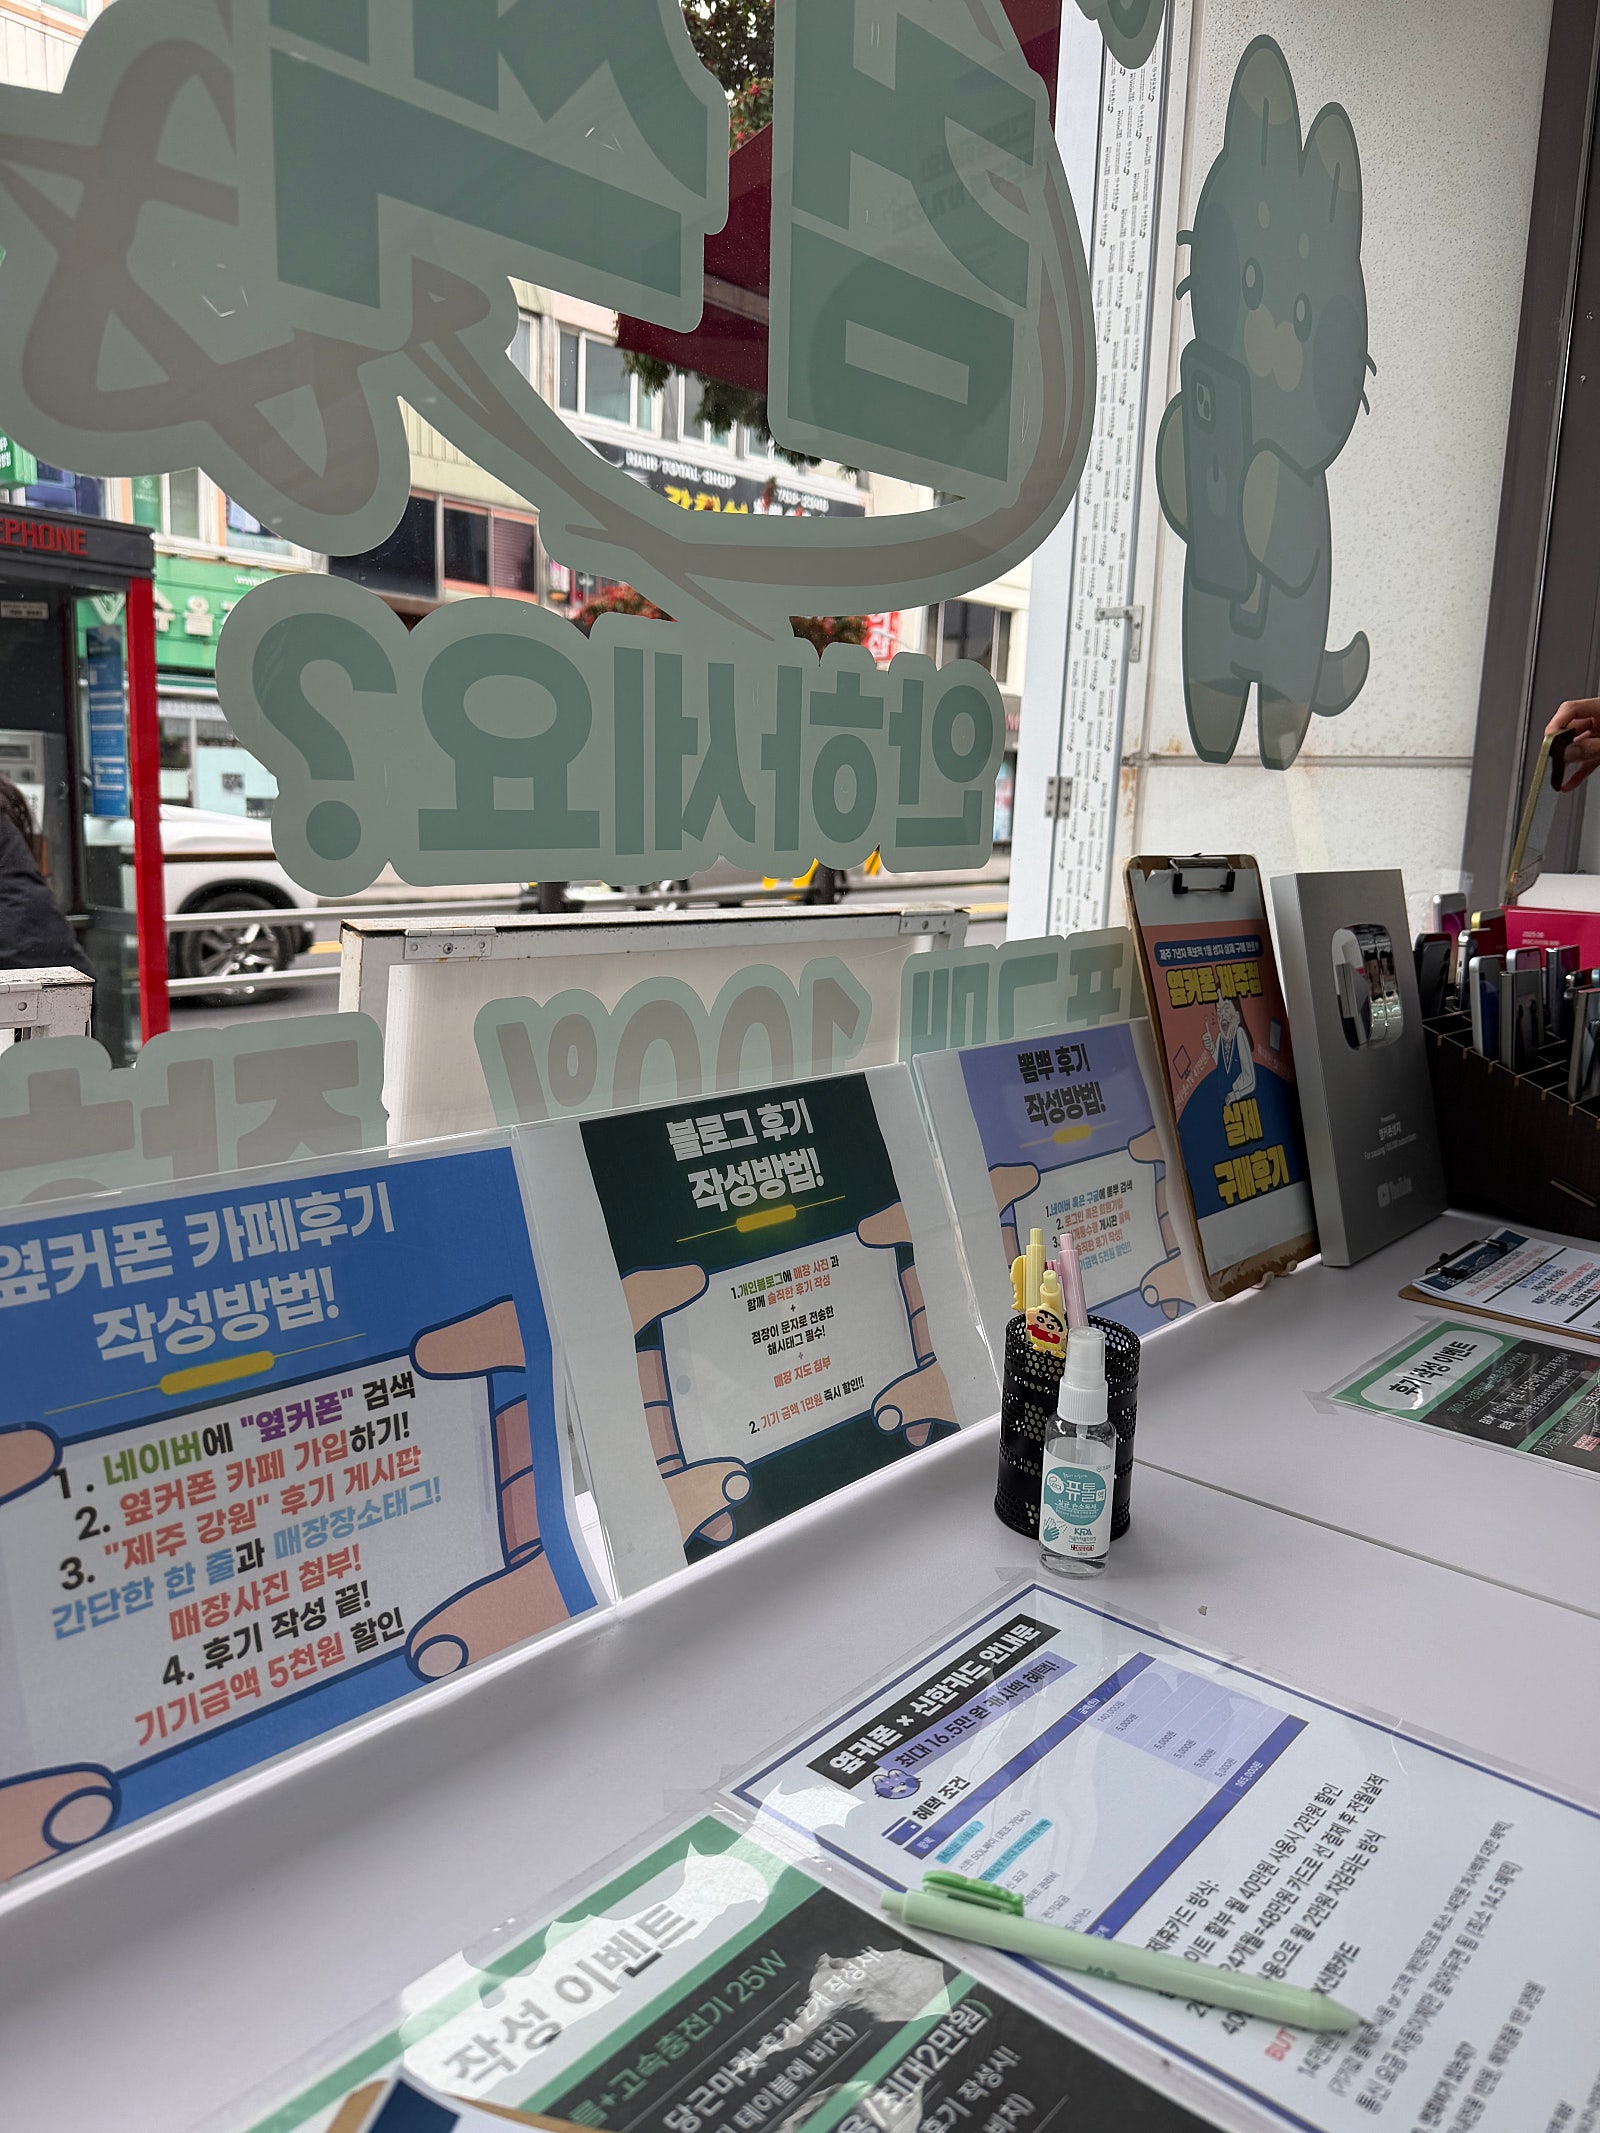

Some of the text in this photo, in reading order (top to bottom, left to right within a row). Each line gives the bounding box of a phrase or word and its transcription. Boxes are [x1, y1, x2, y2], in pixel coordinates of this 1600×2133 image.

[660, 460, 700, 481] TOTAL
[700, 469, 736, 489] SHOP
[0, 518, 88, 556] PHONE
[1167, 960, 1263, 1008] 옆커폰 제주점
[1017, 1043, 1091, 1085] 뽐뿌 후기
[1024, 1081, 1106, 1127] 작성방법!
[1223, 1098, 1263, 1148] 실제
[665, 1097, 815, 1163] 블로그 후기
[687, 1146, 825, 1214] 작성방법!
[1213, 1143, 1289, 1206] 구매후기
[1064, 1210, 1084, 1227] 로그인
[0, 1181, 396, 1306] 옆커폰 카페후기
[793, 1262, 812, 1282] 매장
[812, 1258, 830, 1276] 사진
[746, 1274, 832, 1312] 함께 솔직한 후기 작성
[93, 1266, 338, 1365] 작성방법!
[751, 1305, 835, 1345] 점장이 문자로 전송한
[767, 1326, 827, 1357] 해시태그 필수!
[1432, 1341, 1478, 1363] 이벤트
[774, 1356, 832, 1389] 매장 지도 첨부
[760, 1411, 780, 1430] 기기
[780, 1403, 800, 1421] 금액
[800, 1393, 823, 1416] 1만원
[823, 1385, 842, 1403] 즉시
[842, 1375, 866, 1396] 할인!!
[104, 1423, 233, 1486] 네이버에
[241, 1388, 354, 1442] "옆커폰"
[362, 1370, 417, 1411] 검색
[119, 1468, 215, 1527] 옆커폰
[226, 1450, 285, 1495] 카페
[294, 1412, 411, 1475] 가입하기!
[104, 1521, 187, 1571] "제주
[197, 1494, 270, 1542] 강원"
[281, 1479, 335, 1515] 후기
[344, 1445, 422, 1496] 게시판
[1074, 1527, 1093, 1536] KFDA
[51, 1476, 442, 1641] 간단한 한 줄과 매장장소태그!
[169, 1544, 363, 1642] 매장사진 첨부!
[161, 1580, 371, 1688] 4. 후기 작성 끝!
[134, 1606, 406, 1747] 기기금액 5천원 할인
[829, 1623, 1042, 1775] 옆커폰 신한카드 안내문
[894, 1743, 933, 1769] 최대
[1022, 1660, 1061, 1686] 혜택!
[1115, 1713, 1139, 1733] 5,000원
[1154, 1729, 1178, 1751] 5,000원
[1173, 1738, 1197, 1760] 5,000원
[1194, 1748, 1217, 1769] 5,000원
[1214, 1757, 1238, 1779] 5,000원
[1234, 1760, 1264, 1788] 165,000원
[1346, 1772, 1389, 1815] 전월실적
[912, 1775, 971, 1821] 혜택 조건
[1338, 1811, 1358, 1826] 후
[1312, 1843, 1335, 1860] 선
[1321, 1822, 1352, 1847] 결제
[1355, 1829, 1387, 1853] 방식
[1203, 1782, 1344, 1938] 할부 월 40만원 사용시 2만원 할인
[1286, 1856, 1324, 1892] 카드로
[1324, 1853, 1370, 1897] 차감되는
[1145, 1880, 1221, 1952] 제휴카드 방식:
[1301, 1892, 1339, 1928] 2만원
[1289, 1923, 1316, 1942] 월
[443, 1902, 699, 2084] 작성 이벤트
[568, 1949, 787, 2128] 름+고속충전기 25W
[662, 2047, 768, 2133] 당근마켓
[823, 1945, 884, 1992] 작성시!
[1264, 2026, 1298, 2062] BUT
[733, 2021, 857, 2129] 테이블에 비치)
[956, 2045, 1022, 2102] 작성시!
